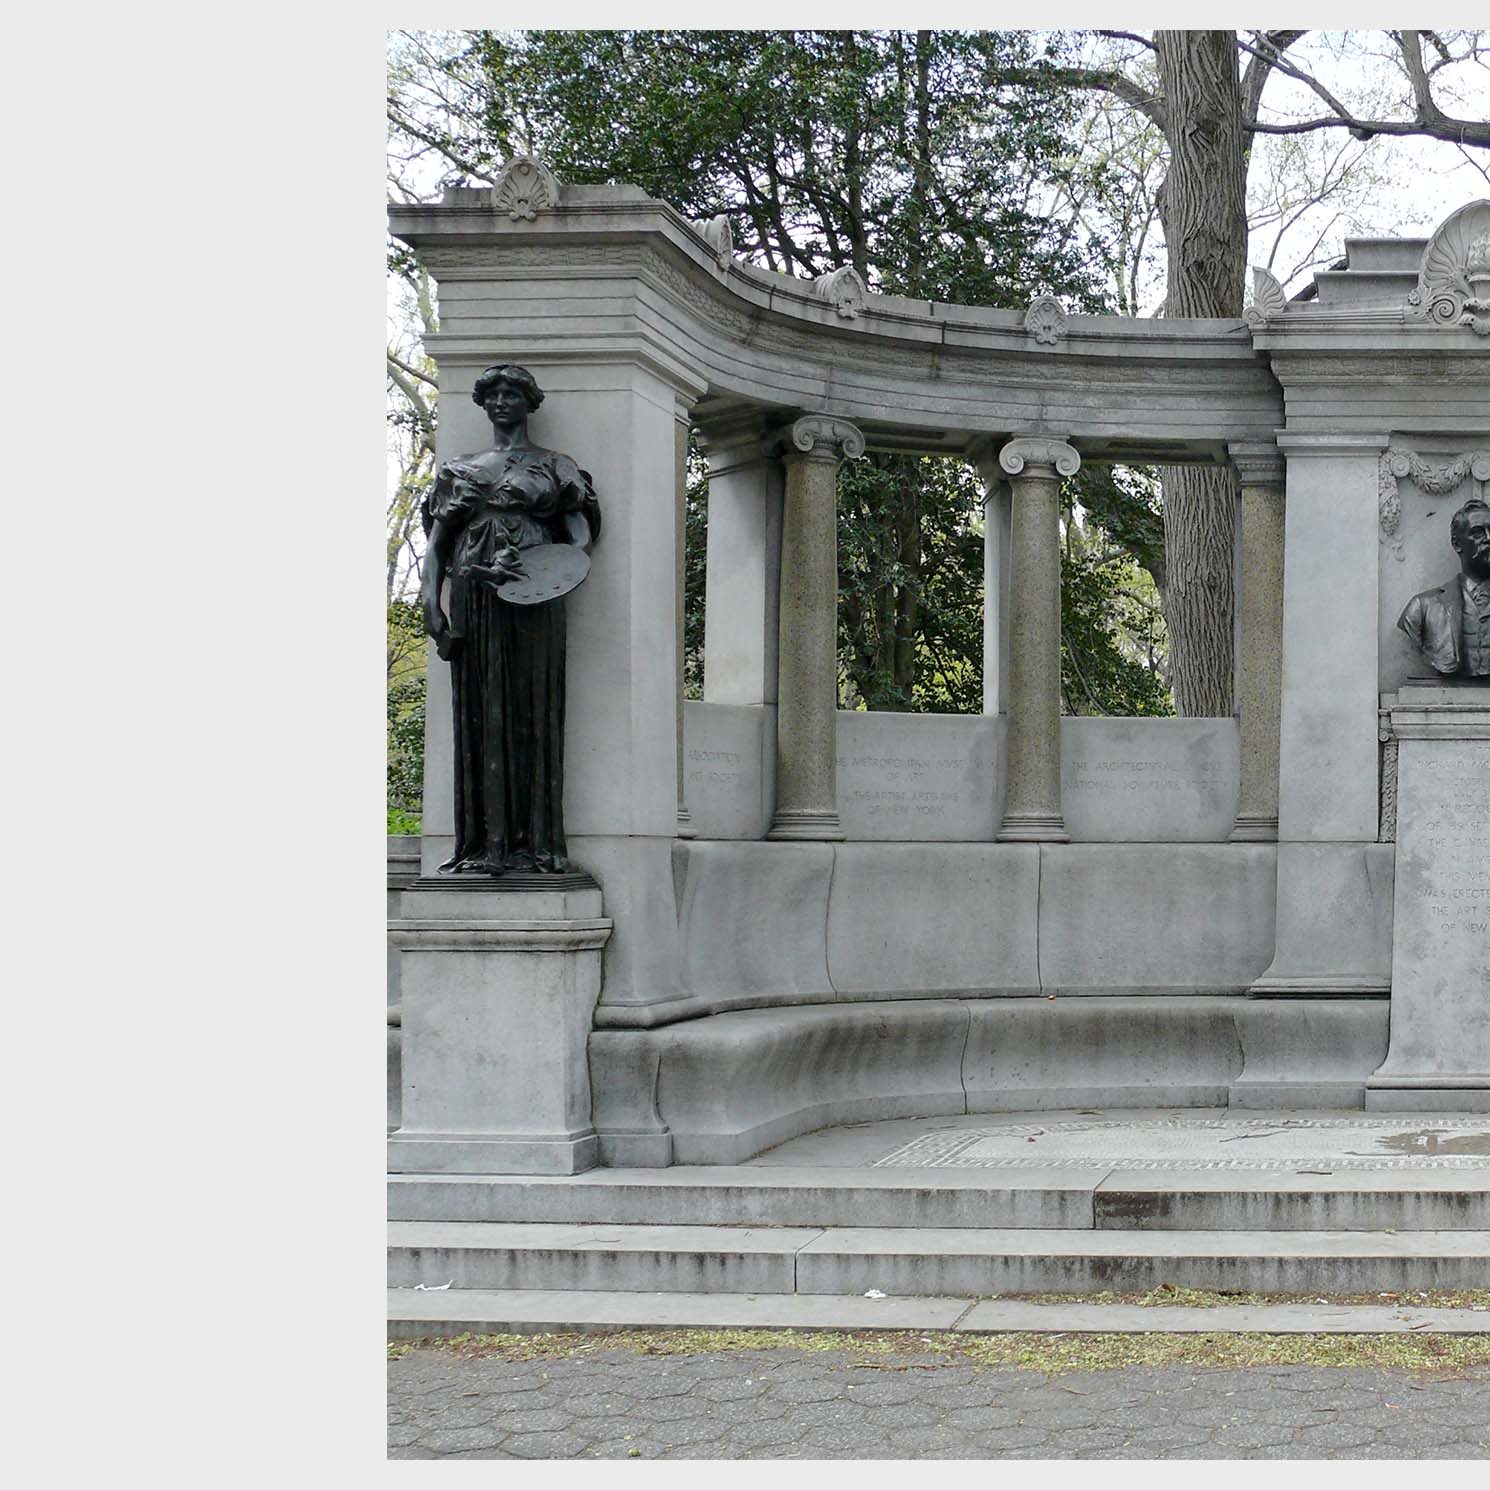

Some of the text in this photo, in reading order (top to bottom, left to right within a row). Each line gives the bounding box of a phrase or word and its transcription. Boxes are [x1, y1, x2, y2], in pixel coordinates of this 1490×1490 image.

[1431, 905, 1449, 917] THE
[1456, 905, 1478, 917] ART
[1441, 922, 1456, 932] OF
[1464, 922, 1488, 933] NEW
